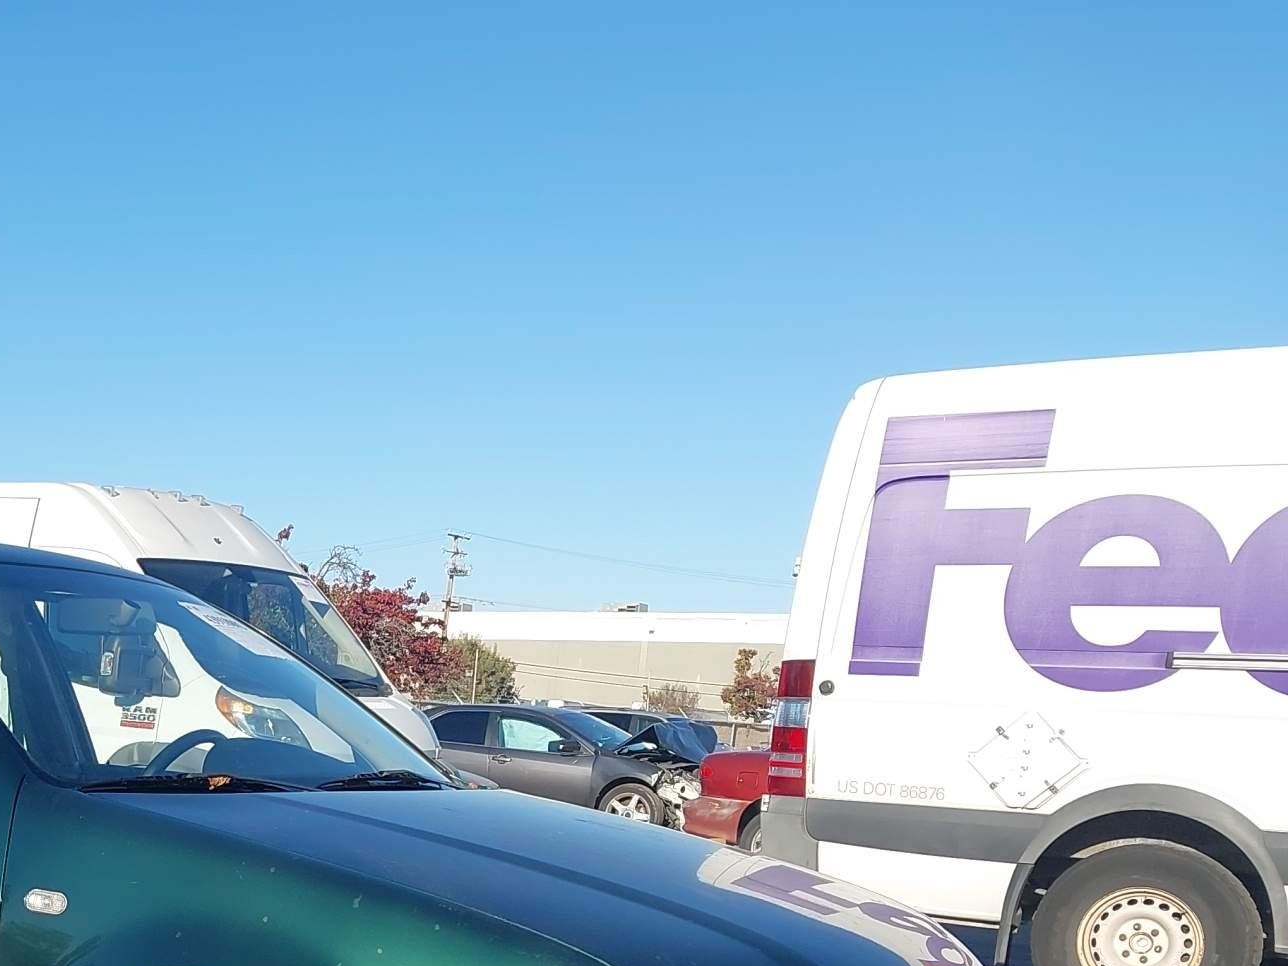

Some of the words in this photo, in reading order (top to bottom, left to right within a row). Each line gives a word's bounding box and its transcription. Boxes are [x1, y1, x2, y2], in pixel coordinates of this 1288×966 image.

[120, 712, 156, 722] 3500
[837, 779, 859, 794] US
[863, 781, 896, 797] DOT
[899, 784, 945, 801] 86876
